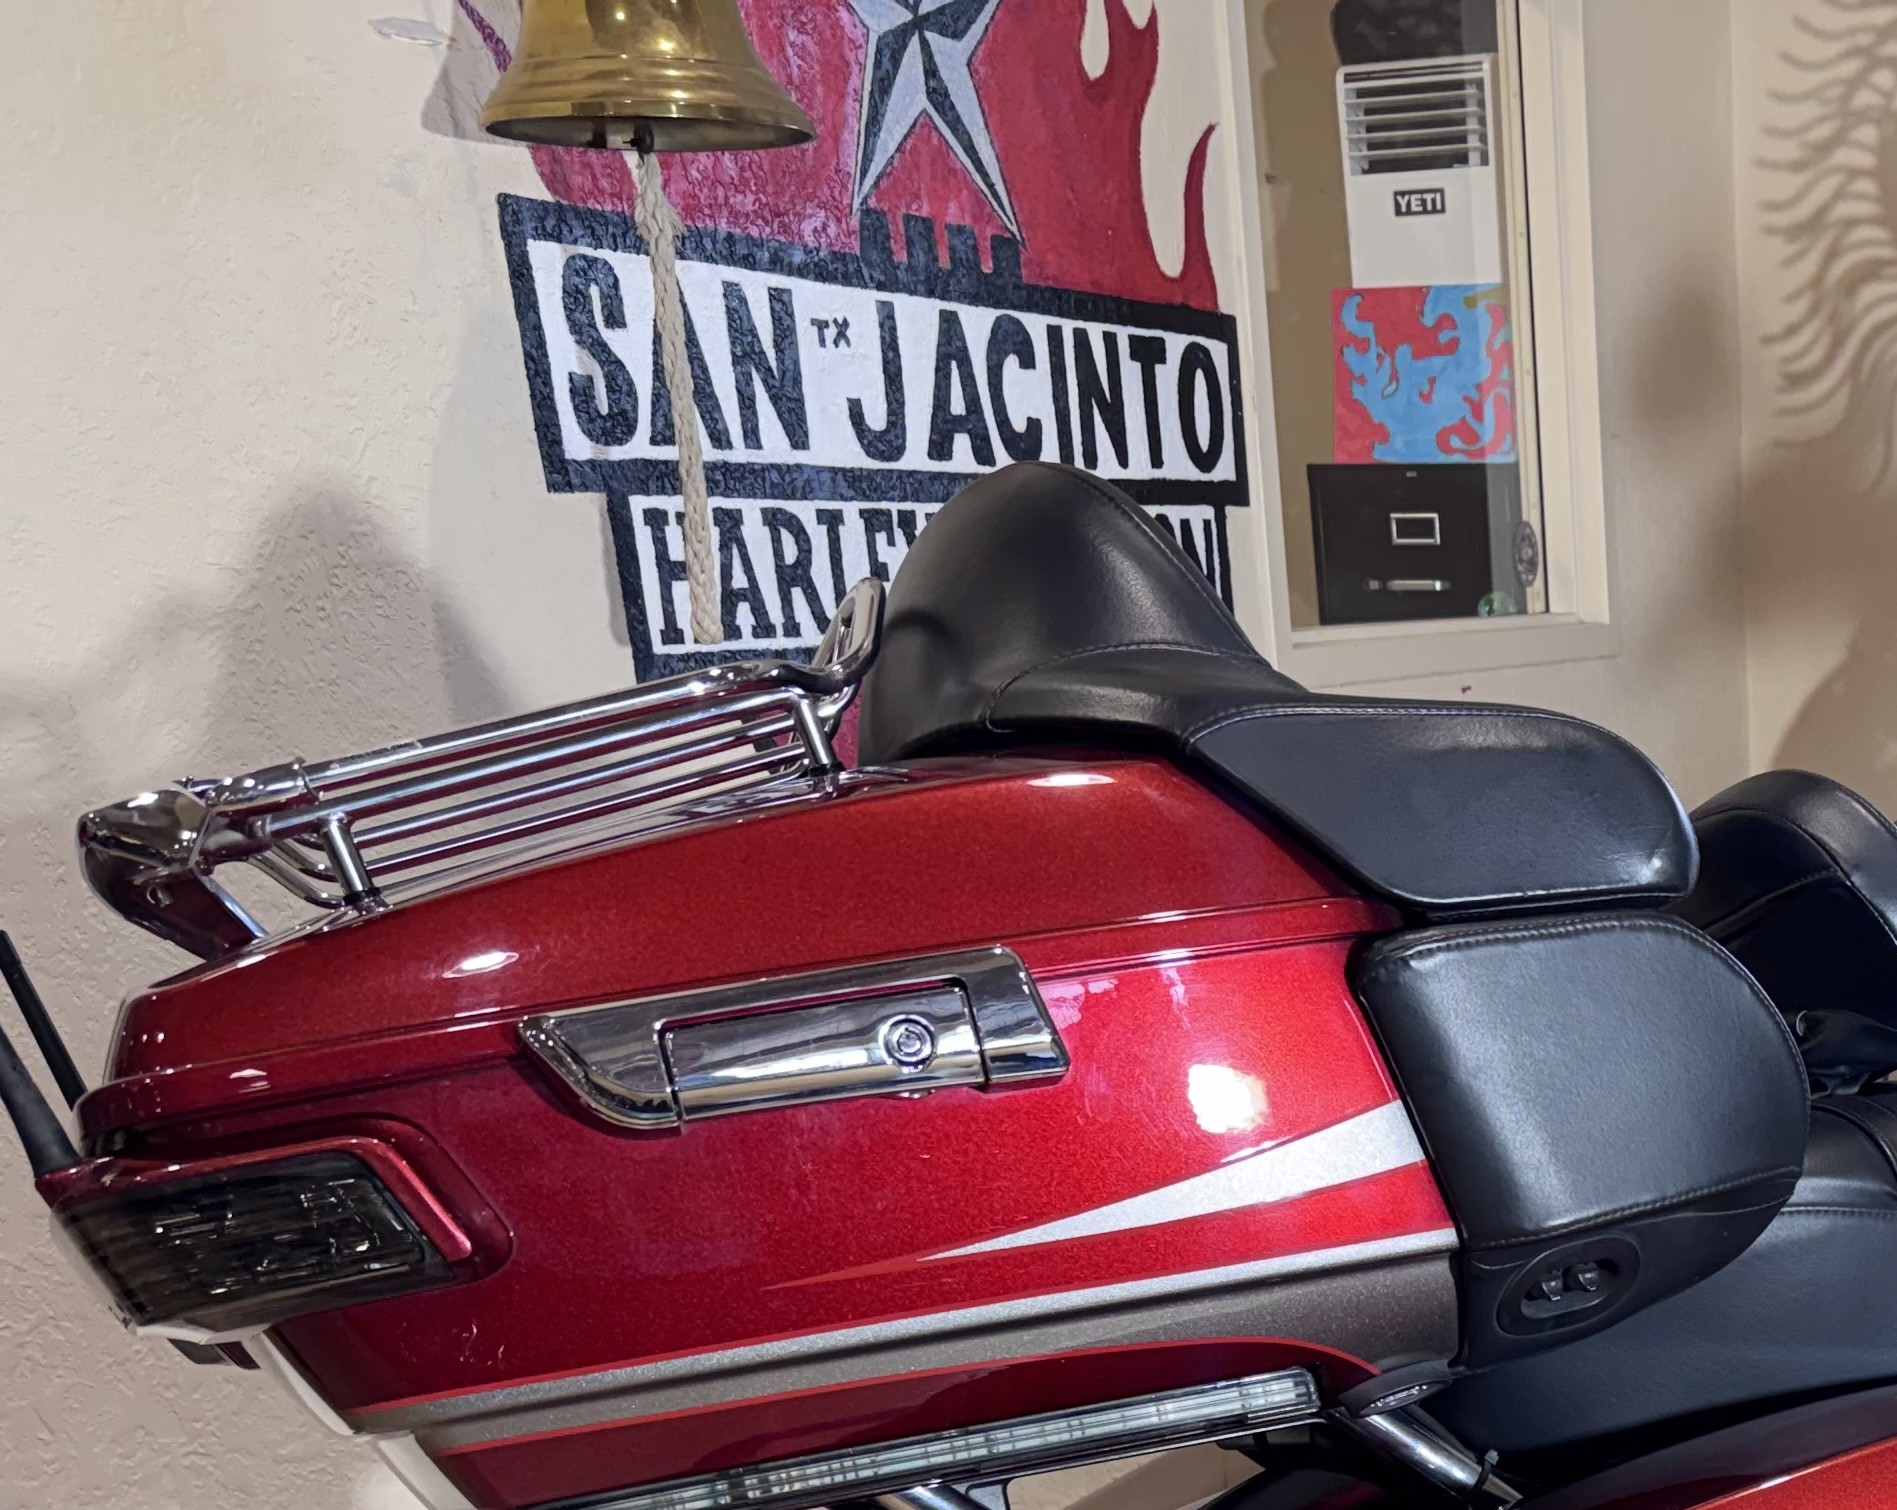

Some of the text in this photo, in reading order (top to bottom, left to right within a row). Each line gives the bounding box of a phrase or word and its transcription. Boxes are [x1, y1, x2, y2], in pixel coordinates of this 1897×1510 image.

[1396, 193, 1442, 213] YETI
[562, 253, 1225, 474] SAN TX JACINTO
